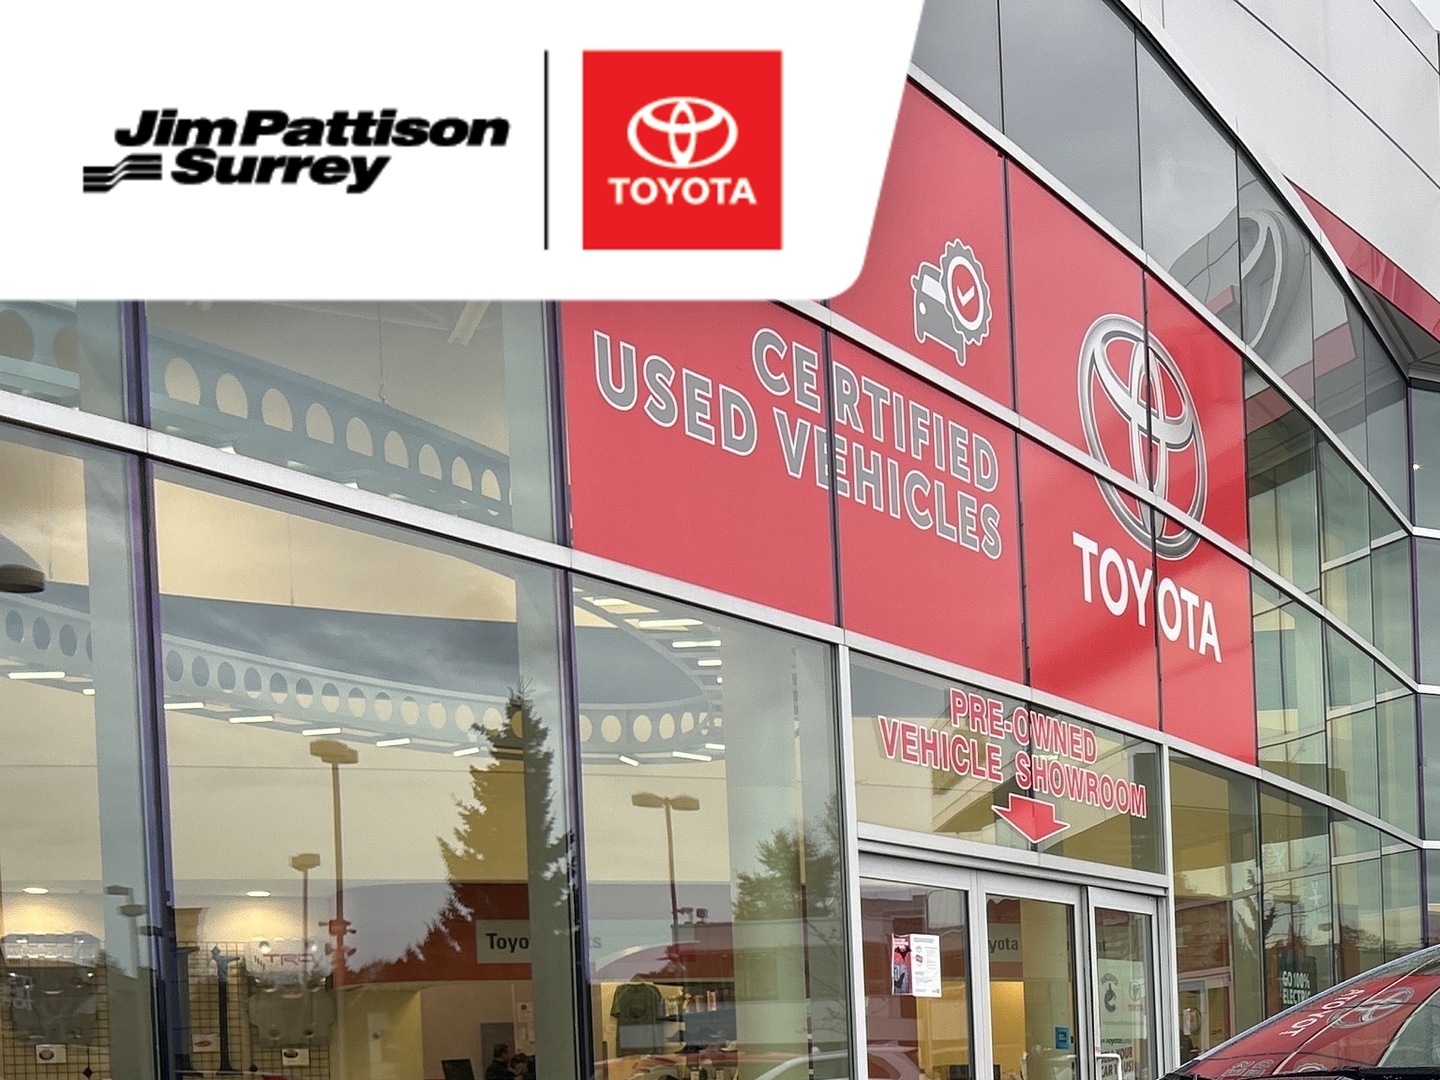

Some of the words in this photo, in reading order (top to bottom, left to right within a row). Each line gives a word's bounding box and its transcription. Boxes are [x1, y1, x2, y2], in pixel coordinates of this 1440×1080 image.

[593, 330, 758, 457] USED
[773, 406, 1002, 560] VEHICLES
[751, 327, 999, 492] CERTIFIED
[1072, 530, 1223, 663] TOYOTA
[877, 715, 1004, 783] VEHICLE
[1015, 750, 1147, 819] SHOWROOM
[950, 687, 1098, 765] PRE-OWNED
[485, 932, 530, 953] Toyo
[988, 937, 1019, 953] yota
[1282, 970, 1292, 987] GO
